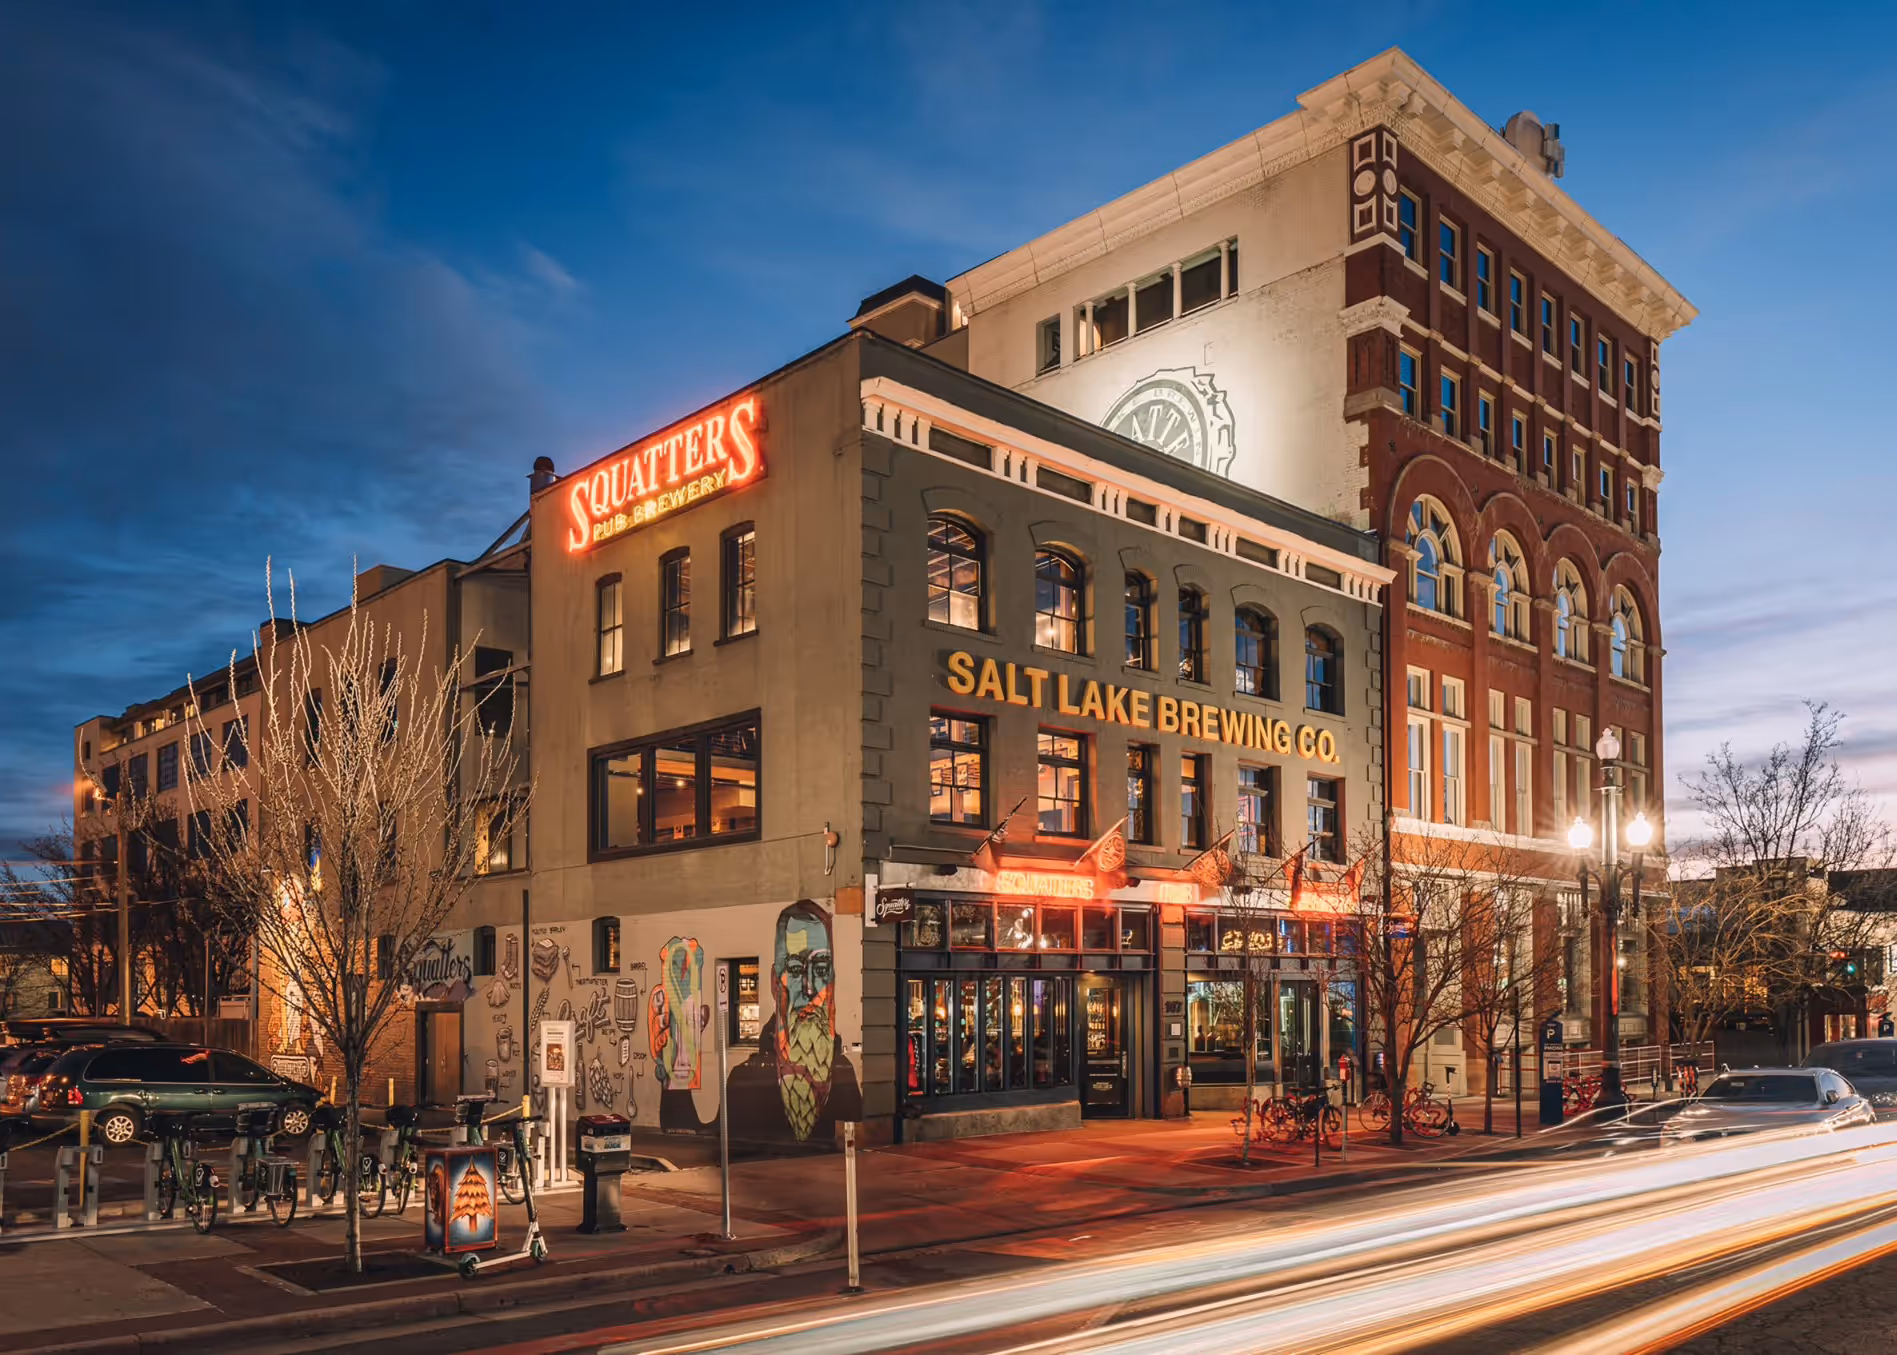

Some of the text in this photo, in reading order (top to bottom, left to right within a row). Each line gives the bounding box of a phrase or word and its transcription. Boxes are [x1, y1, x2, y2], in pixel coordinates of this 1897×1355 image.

[568, 396, 756, 553] SQUATTERS
[593, 468, 727, 541] PUB BREWERY
[947, 651, 1341, 764] SALT LAKE BREWING CO.
